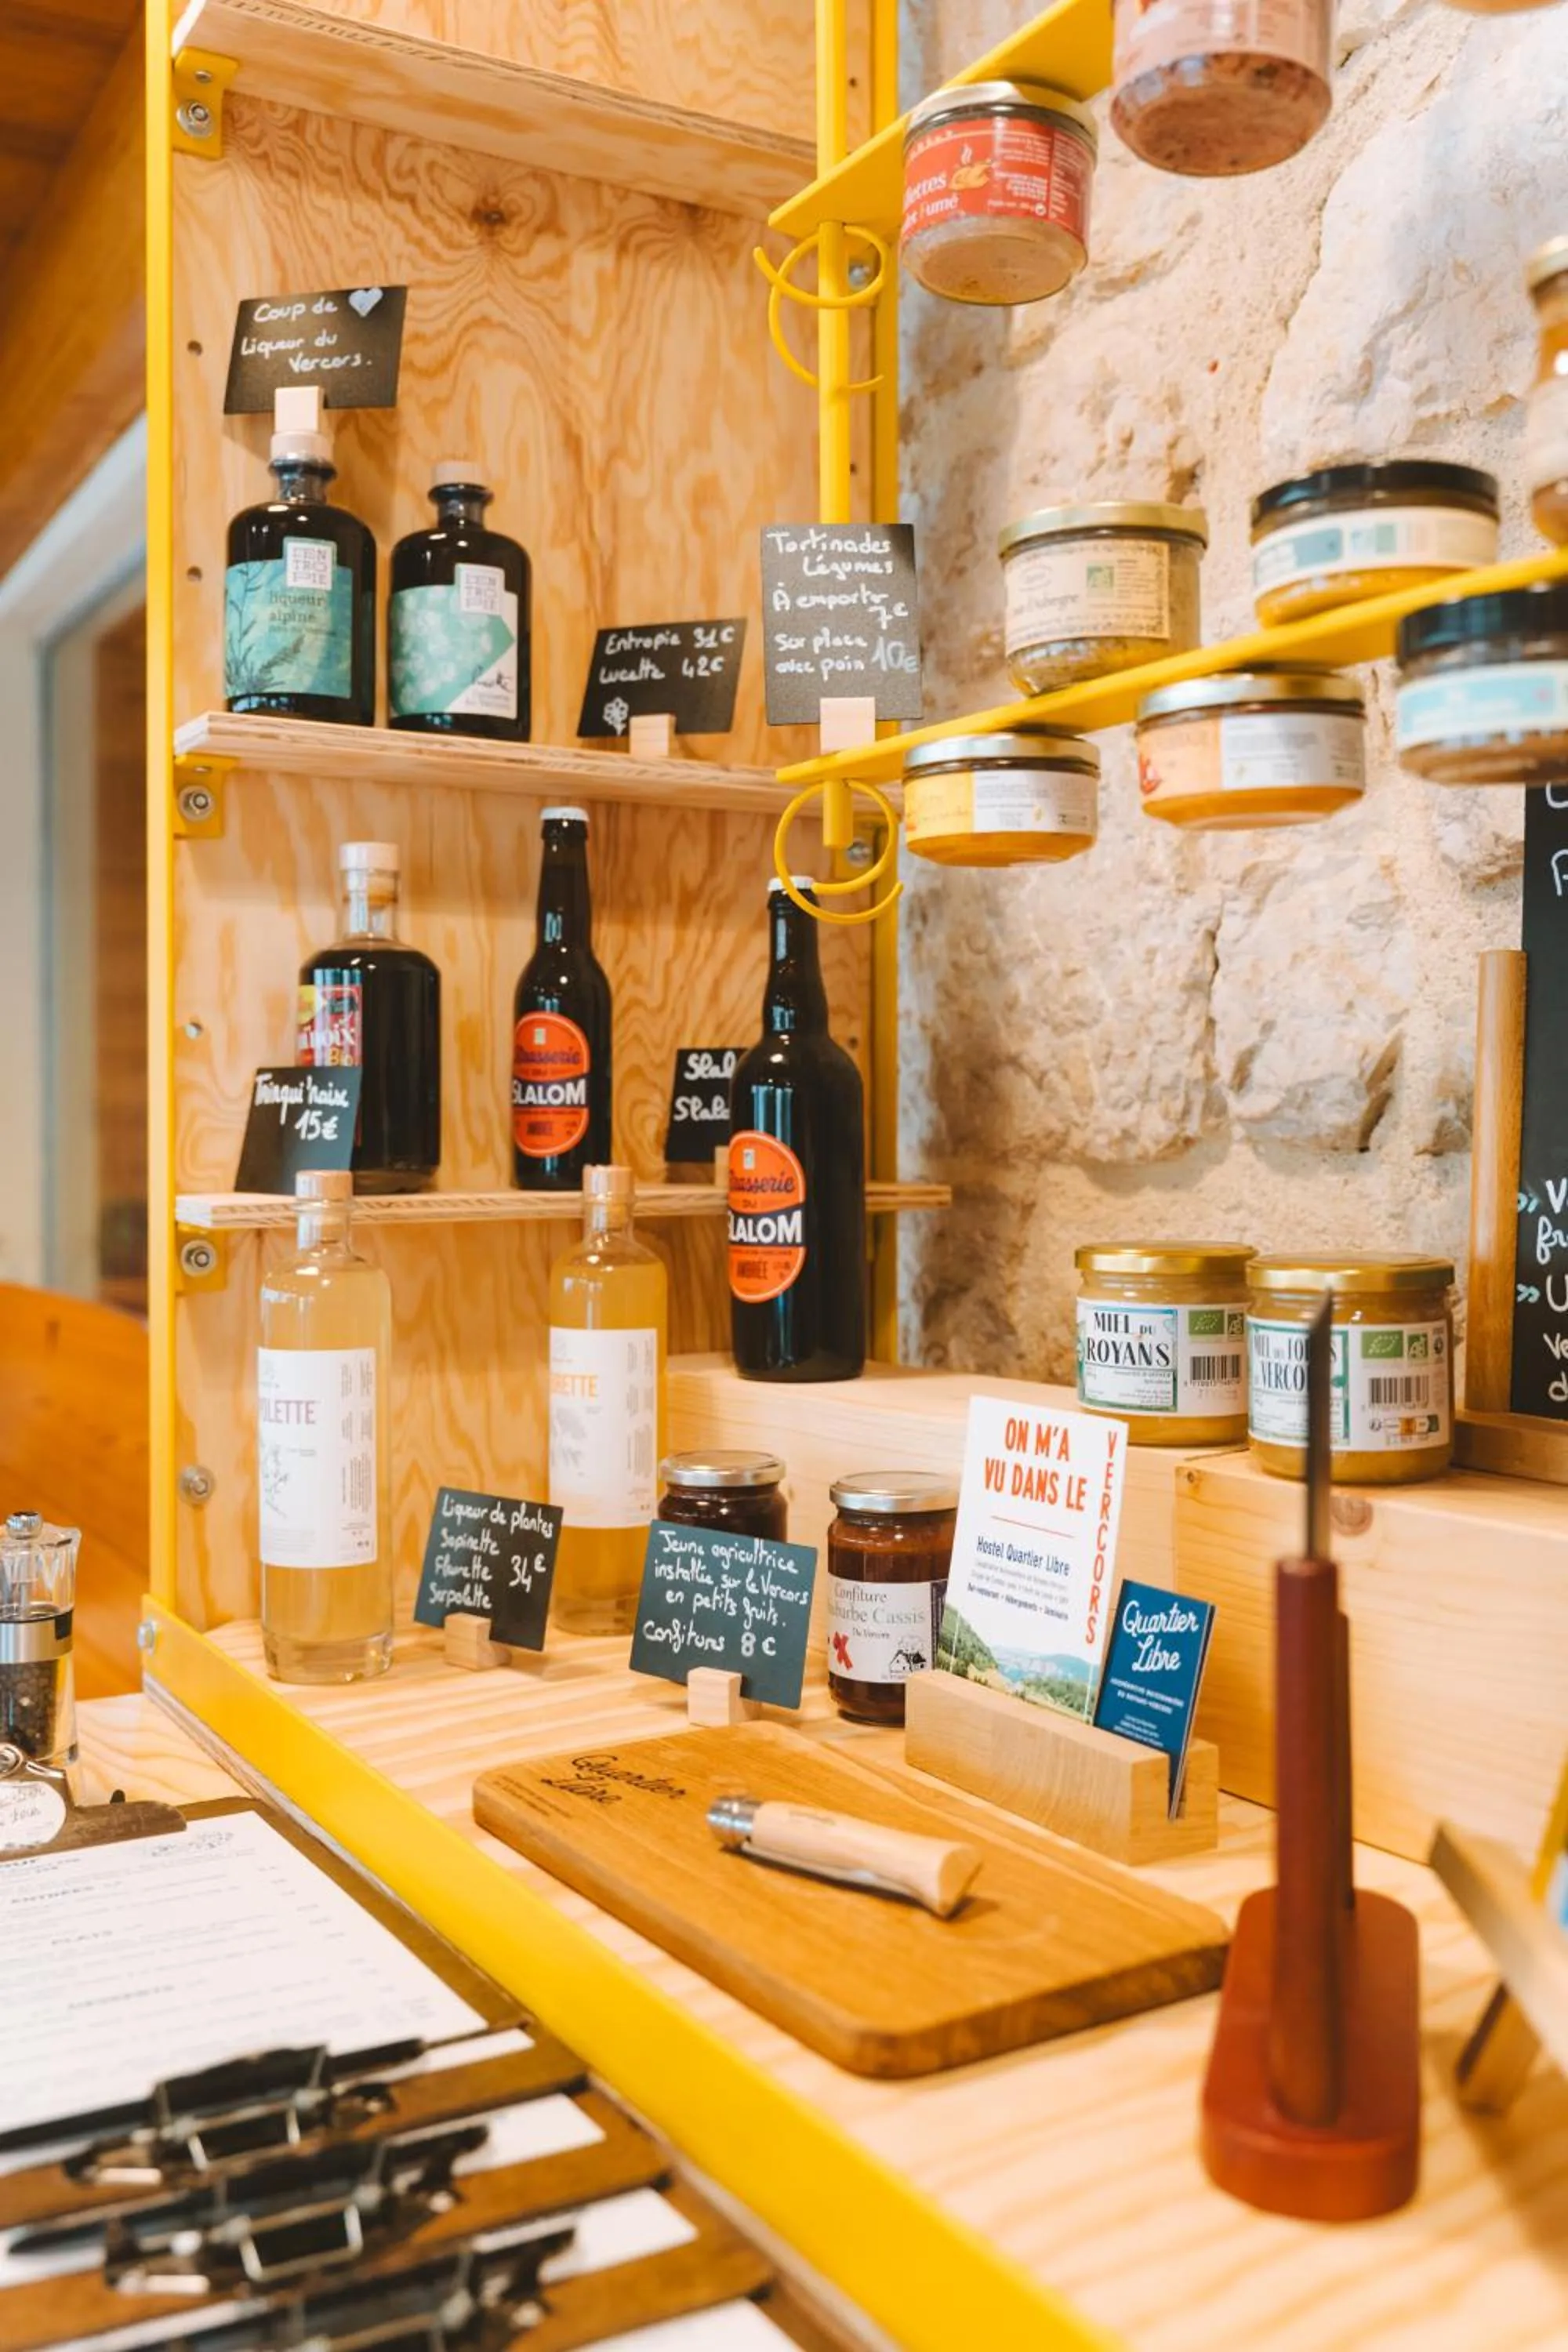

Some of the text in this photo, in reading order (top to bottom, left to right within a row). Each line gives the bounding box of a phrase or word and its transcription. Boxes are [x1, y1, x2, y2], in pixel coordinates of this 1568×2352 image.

[254, 296, 338, 322] Coup de
[241, 329, 338, 359] Liqueur du
[766, 528, 891, 555] Tartinades
[803, 554, 892, 580] Légumes
[797, 583, 888, 611] emporter
[270, 609, 318, 626] alpine
[604, 631, 682, 656] Entropie
[775, 633, 806, 652] Sur
[813, 628, 868, 653] place
[599, 659, 666, 684] Lucette
[775, 655, 866, 681] avec pain
[295, 1109, 339, 1141] 15€
[1093, 1312, 1131, 1334] MIEL
[1087, 1337, 1171, 1368] ROYANS
[1004, 1417, 1071, 1463] ON M'A
[984, 1457, 1088, 1512] VU DANS LE
[441, 1494, 554, 1539] Liqueur de plantes
[659, 1530, 799, 1574] Jeune agricultrice
[1085, 1431, 1118, 1646] VERCORS
[976, 1535, 1004, 1559] Hostel
[1006, 1543, 1044, 1569] Quartier
[1046, 1555, 1071, 1577] Libre
[429, 1582, 493, 1610] Serpolette
[655, 1557, 809, 1605] installée sur le Vercors
[834, 1582, 887, 1604] Confiture
[666, 1589, 685, 1604] en
[693, 1586, 738, 1617] petits
[873, 1607, 926, 1625] Cassis
[1122, 1599, 1200, 1638] Quartier
[642, 1617, 725, 1653] Confitures
[1131, 1635, 1182, 1672] Libre
